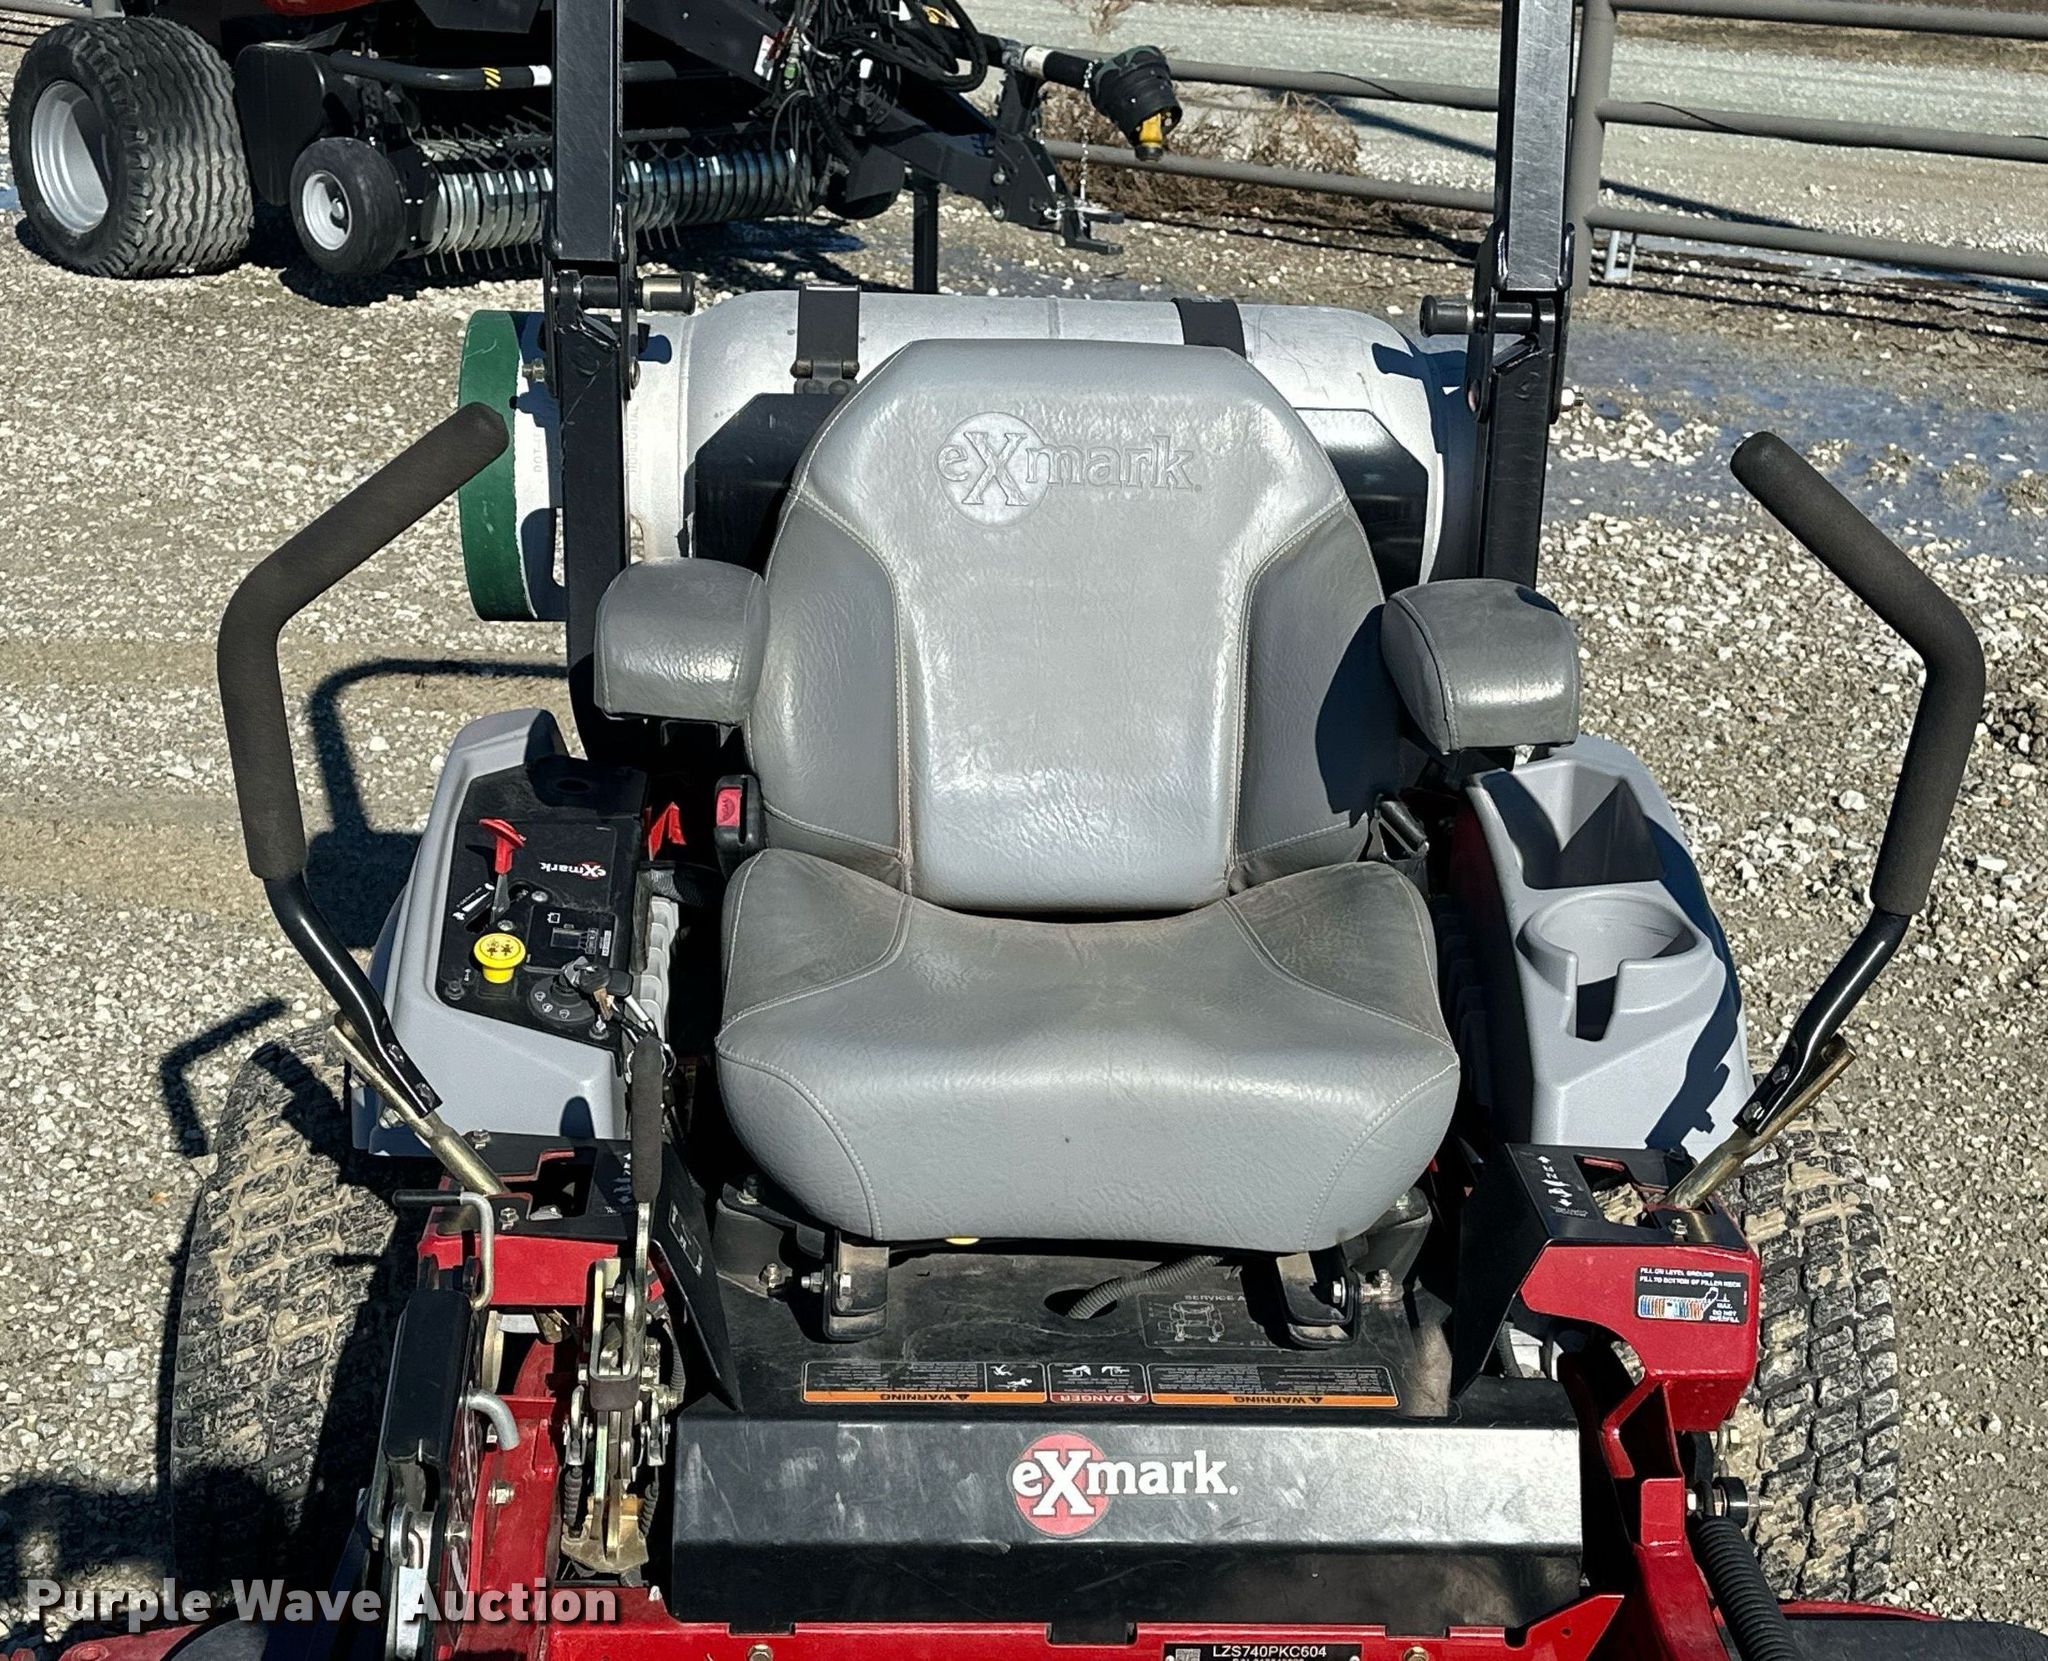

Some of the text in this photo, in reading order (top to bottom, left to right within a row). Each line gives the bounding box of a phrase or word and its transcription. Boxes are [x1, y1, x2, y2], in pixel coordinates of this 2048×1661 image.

[880, 1393, 952, 1401] WARNING
[1060, 1394, 1125, 1402] DANGER
[1233, 1395, 1306, 1404] WARNING
[1213, 1645, 1327, 1657] LZS740PKC604
